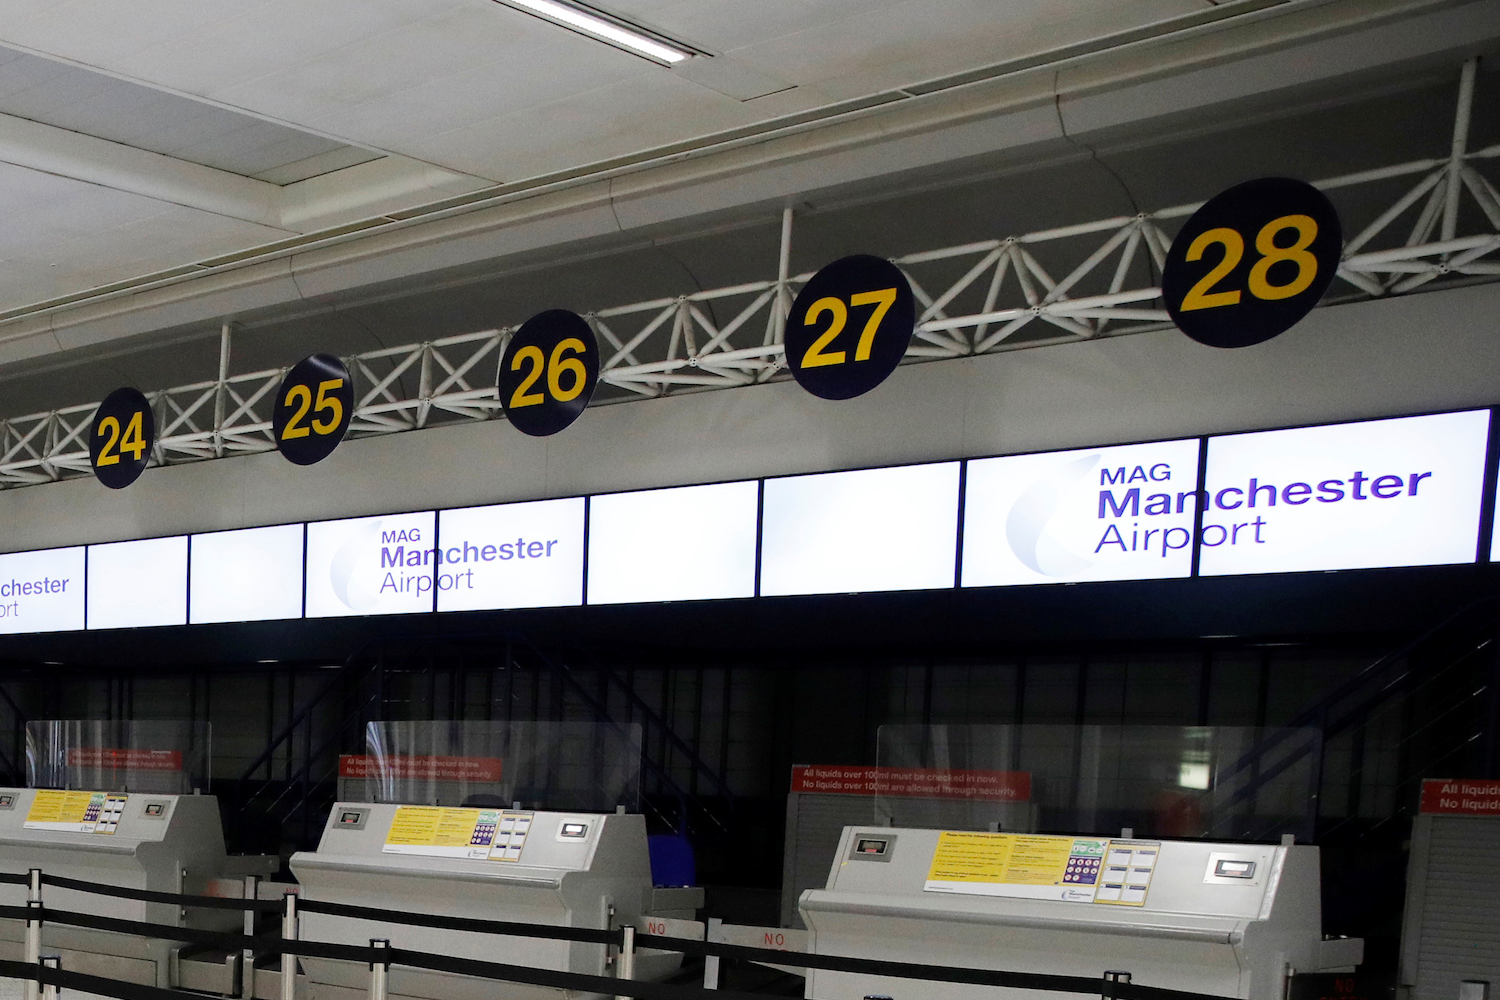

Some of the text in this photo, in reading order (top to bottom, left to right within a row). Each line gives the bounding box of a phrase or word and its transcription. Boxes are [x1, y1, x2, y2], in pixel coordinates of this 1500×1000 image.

[1181, 213, 1318, 312] 28
[801, 287, 897, 369] 27
[509, 337, 587, 409] 26
[281, 378, 344, 441] 25
[96, 411, 147, 467] 24
[1099, 463, 1172, 486] MAG
[1097, 471, 1432, 519] Manchester
[381, 528, 422, 546] MAG
[1094, 515, 1267, 558] Airport
[380, 537, 558, 569] Manchester
[379, 568, 474, 598] Airport
[802, 780, 813, 788] No
[816, 780, 842, 790] liquids
[865, 782, 889, 790] 100ml
[906, 784, 940, 793] allowed
[942, 785, 977, 796] through
[978, 787, 1017, 797] security.
[803, 769, 814, 777] All
[816, 769, 842, 779] liquids
[865, 771, 889, 779] 100ml
[914, 773, 925, 781] be
[926, 774, 964, 782] checked
[967, 774, 975, 782] in
[1441, 784, 1458, 794] All
[1440, 798, 1500, 811] No liquid
[648, 922, 666, 934] NO
[764, 933, 785, 946] NO
[1335, 978, 1354, 993] NO
